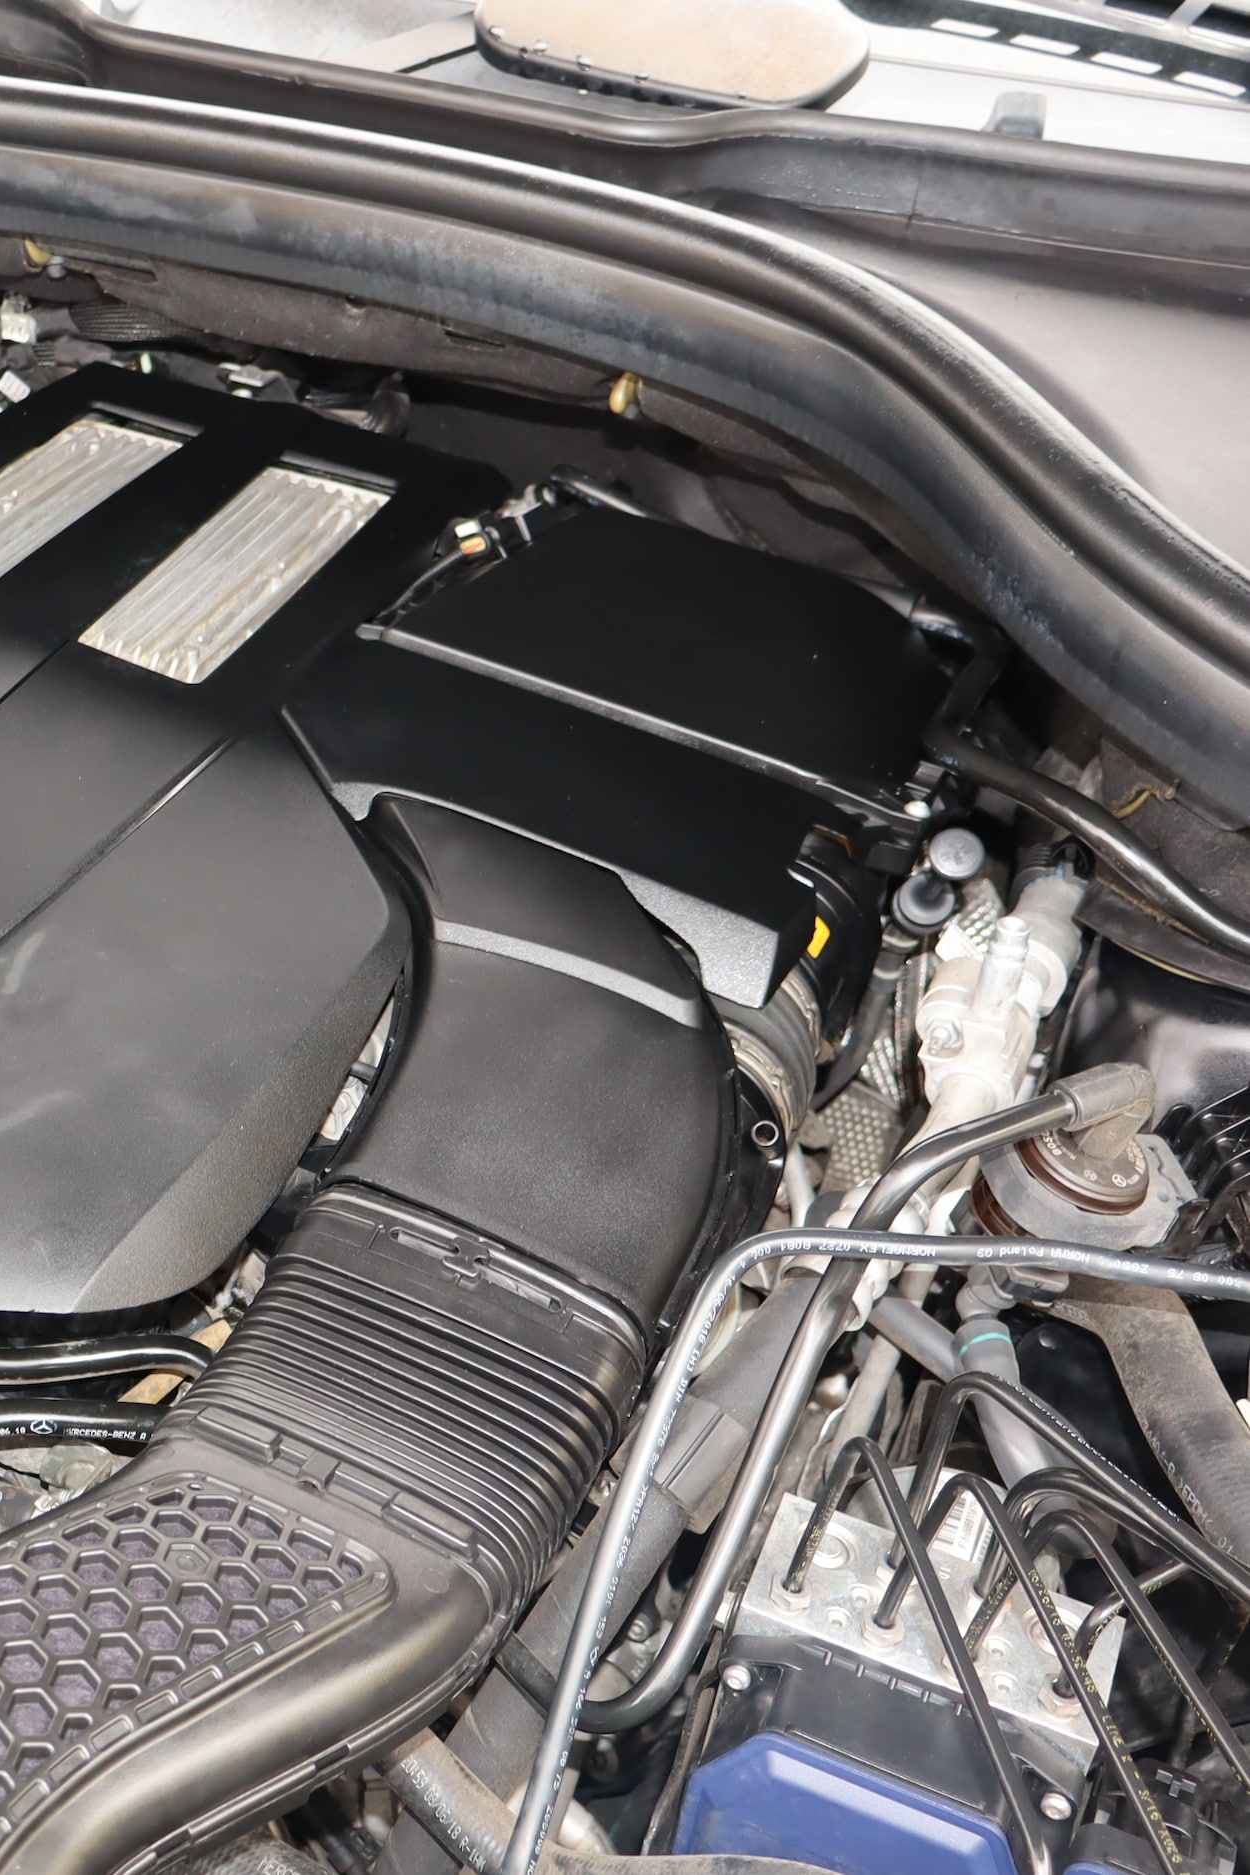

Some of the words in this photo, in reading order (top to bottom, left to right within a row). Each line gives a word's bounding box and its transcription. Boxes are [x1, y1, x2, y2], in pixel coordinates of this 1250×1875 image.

[1042, 1131, 1063, 1157] BOSC
[859, 1244, 935, 1256] NORMAFLEX
[1050, 1248, 1089, 1263] NORMA
[675, 1379, 689, 1403] DIN
[1103, 1715, 1125, 1746] LINE
